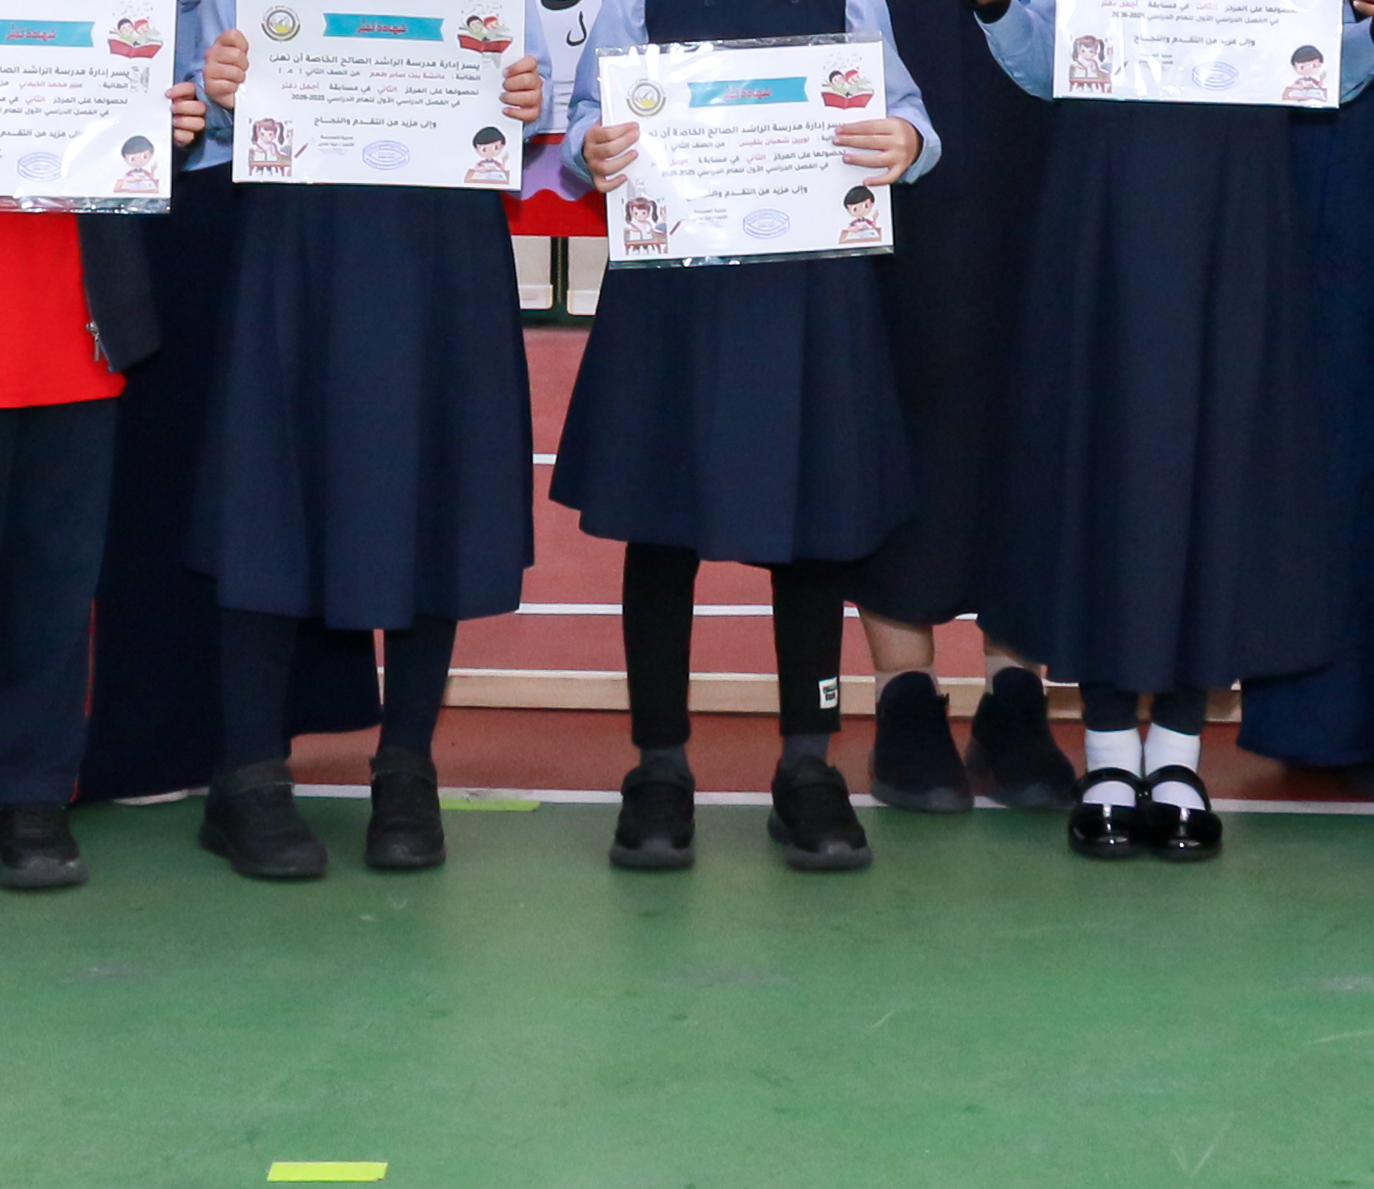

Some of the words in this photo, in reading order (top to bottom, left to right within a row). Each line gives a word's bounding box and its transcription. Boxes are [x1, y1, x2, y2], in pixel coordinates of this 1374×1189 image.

[293, 53, 303, 63] أن
[306, 54, 337, 63] الخاصة
[341, 57, 371, 67] الصالح
[407, 58, 436, 68] مدرسة
